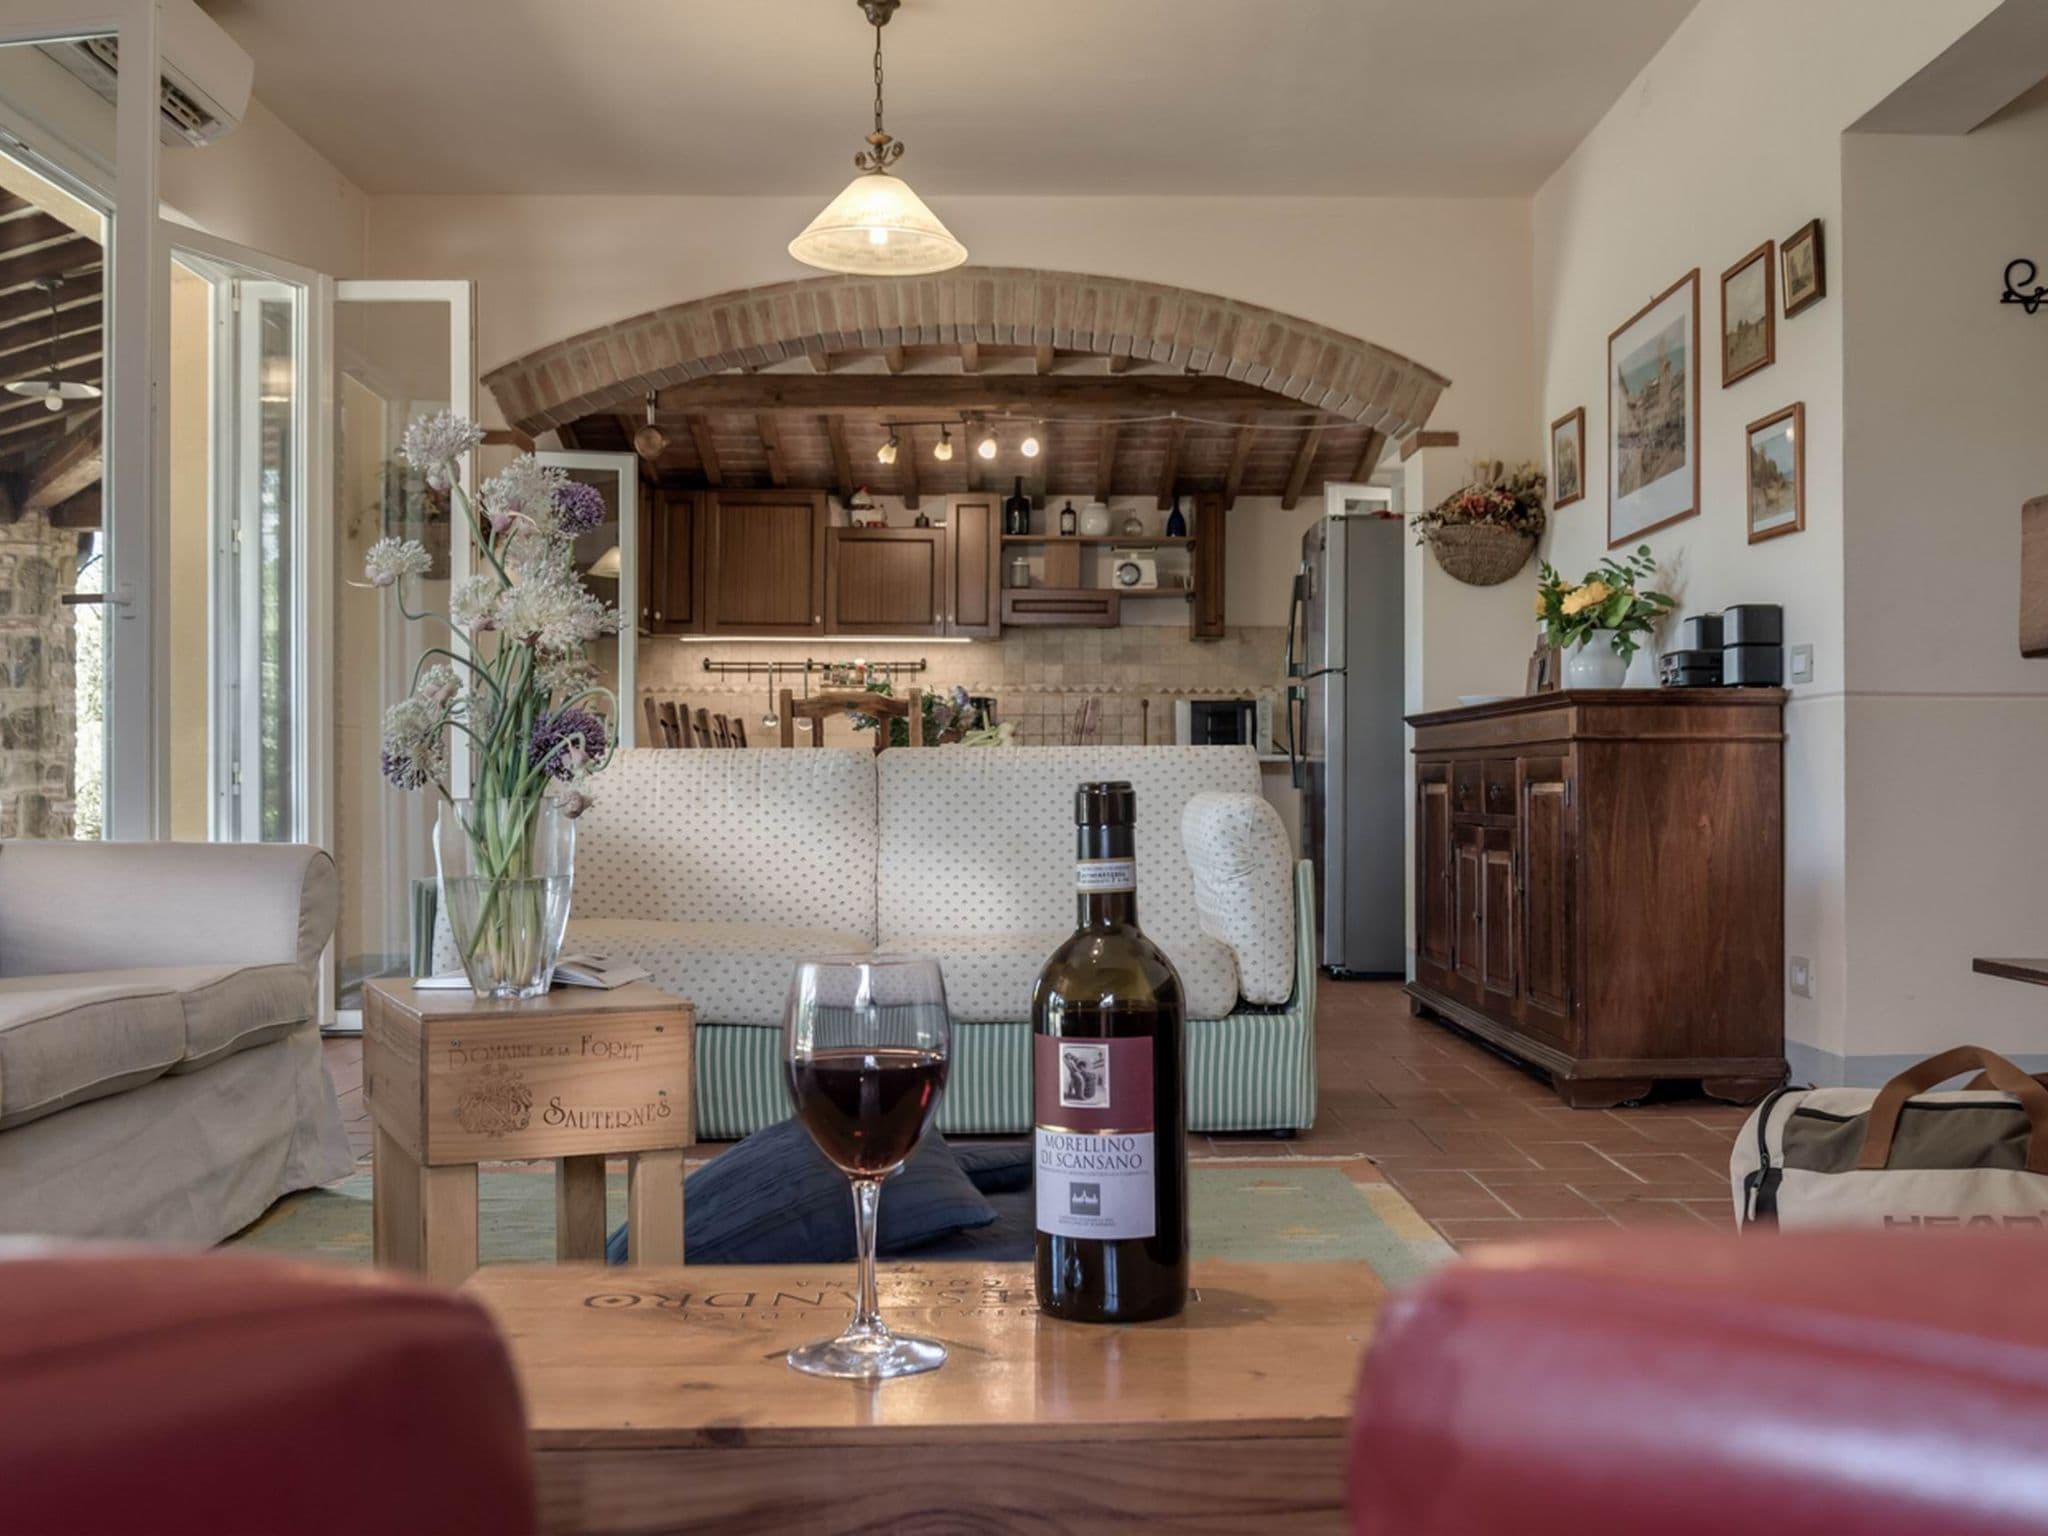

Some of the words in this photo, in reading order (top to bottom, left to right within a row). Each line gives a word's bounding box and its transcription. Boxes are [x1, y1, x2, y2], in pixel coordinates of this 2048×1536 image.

[543, 1095, 672, 1130] SAUTERNES
[1044, 1134, 1136, 1154] MORELLINO
[1040, 1149, 1052, 1165] DI
[1056, 1153, 1143, 1171] SCANSANO
